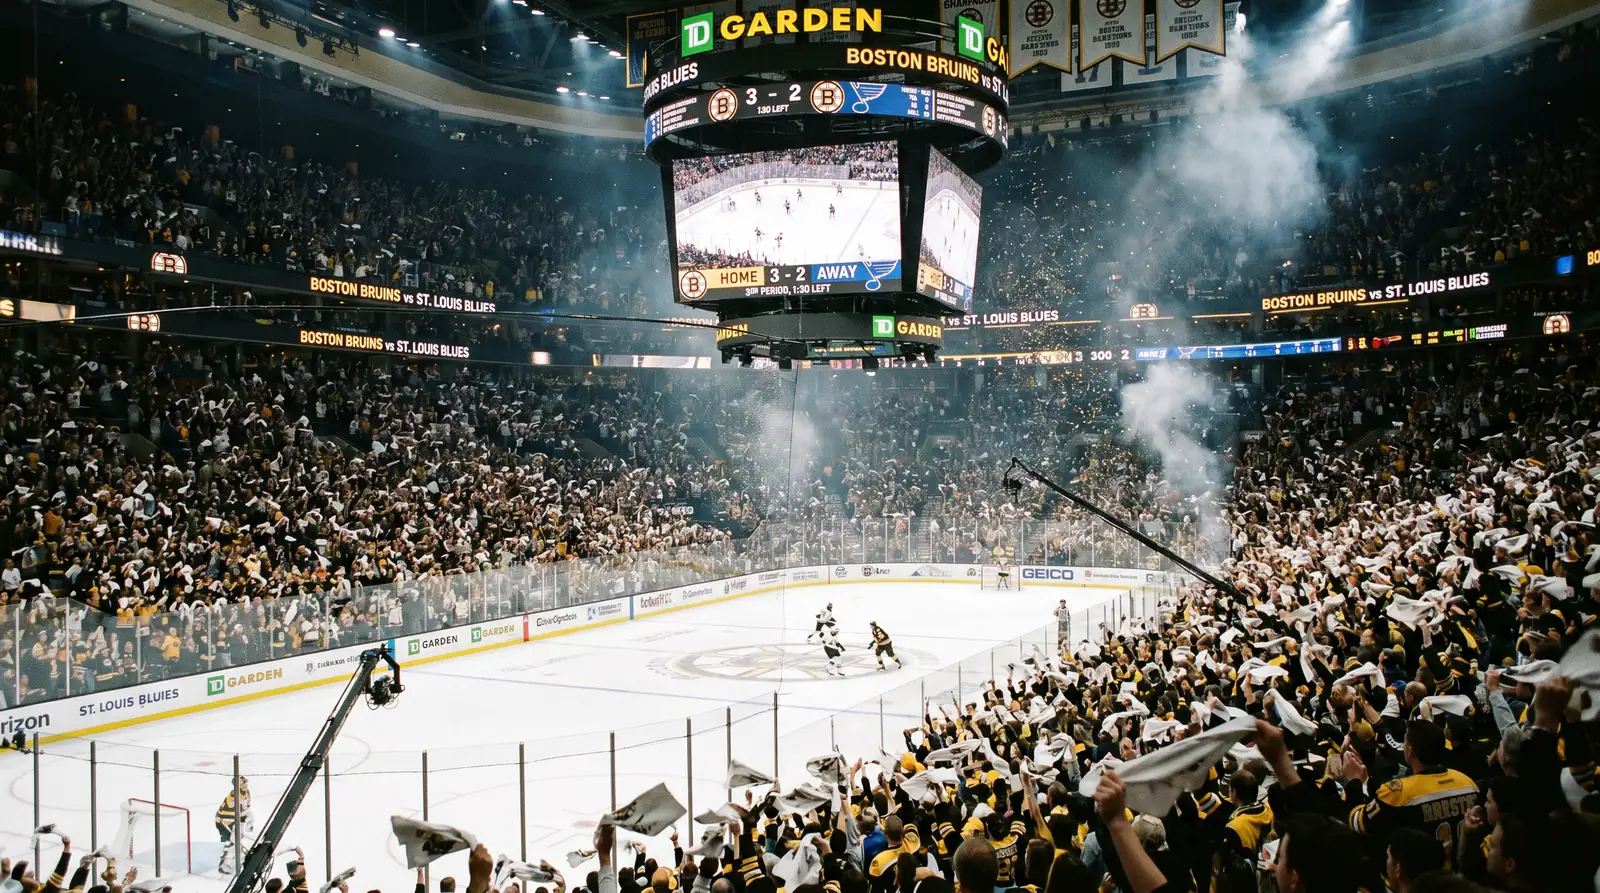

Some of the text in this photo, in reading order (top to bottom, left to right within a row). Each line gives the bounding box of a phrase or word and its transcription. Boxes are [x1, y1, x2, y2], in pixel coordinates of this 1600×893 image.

[683, 21, 710, 49] TD
[720, 8, 882, 40] GARDEN
[961, 23, 983, 54] TD
[661, 62, 699, 90] BLUES
[846, 48, 922, 71] BOSTON
[926, 55, 979, 84] BRUINS
[745, 88, 757, 105] 3
[789, 84, 801, 101] 2
[772, 104, 790, 114] LEFT
[720, 270, 758, 284] HOME
[770, 268, 780, 283] 3
[796, 266, 806, 282] 2
[817, 264, 857, 280] AWAY
[310, 276, 358, 297] BOSTON
[360, 284, 401, 303] BRUINS
[416, 292, 432, 306] ST.
[434, 295, 463, 311] LOUIS
[760, 285, 791, 296] PERIOD,
[792, 284, 810, 294] 1:30
[811, 283, 831, 293] LEFT
[1262, 292, 1314, 310] BOSTON
[1317, 288, 1367, 305] BRUINS
[1385, 285, 1406, 299] ST.
[1408, 279, 1446, 296] LOUIS
[1448, 272, 1489, 291] BLUES
[874, 319, 893, 334] TD
[963, 314, 981, 325] ST.
[983, 312, 1018, 324] LOUIS
[1020, 310, 1059, 323] BLUES
[300, 330, 343, 347] BOSTON
[345, 335, 383, 351] BRUINS
[396, 339, 411, 353] ST.
[412, 342, 439, 356] LOUIS
[440, 345, 470, 359] BLUES
[1090, 350, 1113, 361] 300
[1121, 350, 1130, 360] 2
[1022, 568, 1074, 581] GEICO
[482, 624, 515, 638] GARDEN
[422, 634, 459, 650] GARDEN
[209, 668, 283, 692] TD GARDEN
[79, 703, 97, 717] ST.
[99, 697, 135, 713] LOUIS
